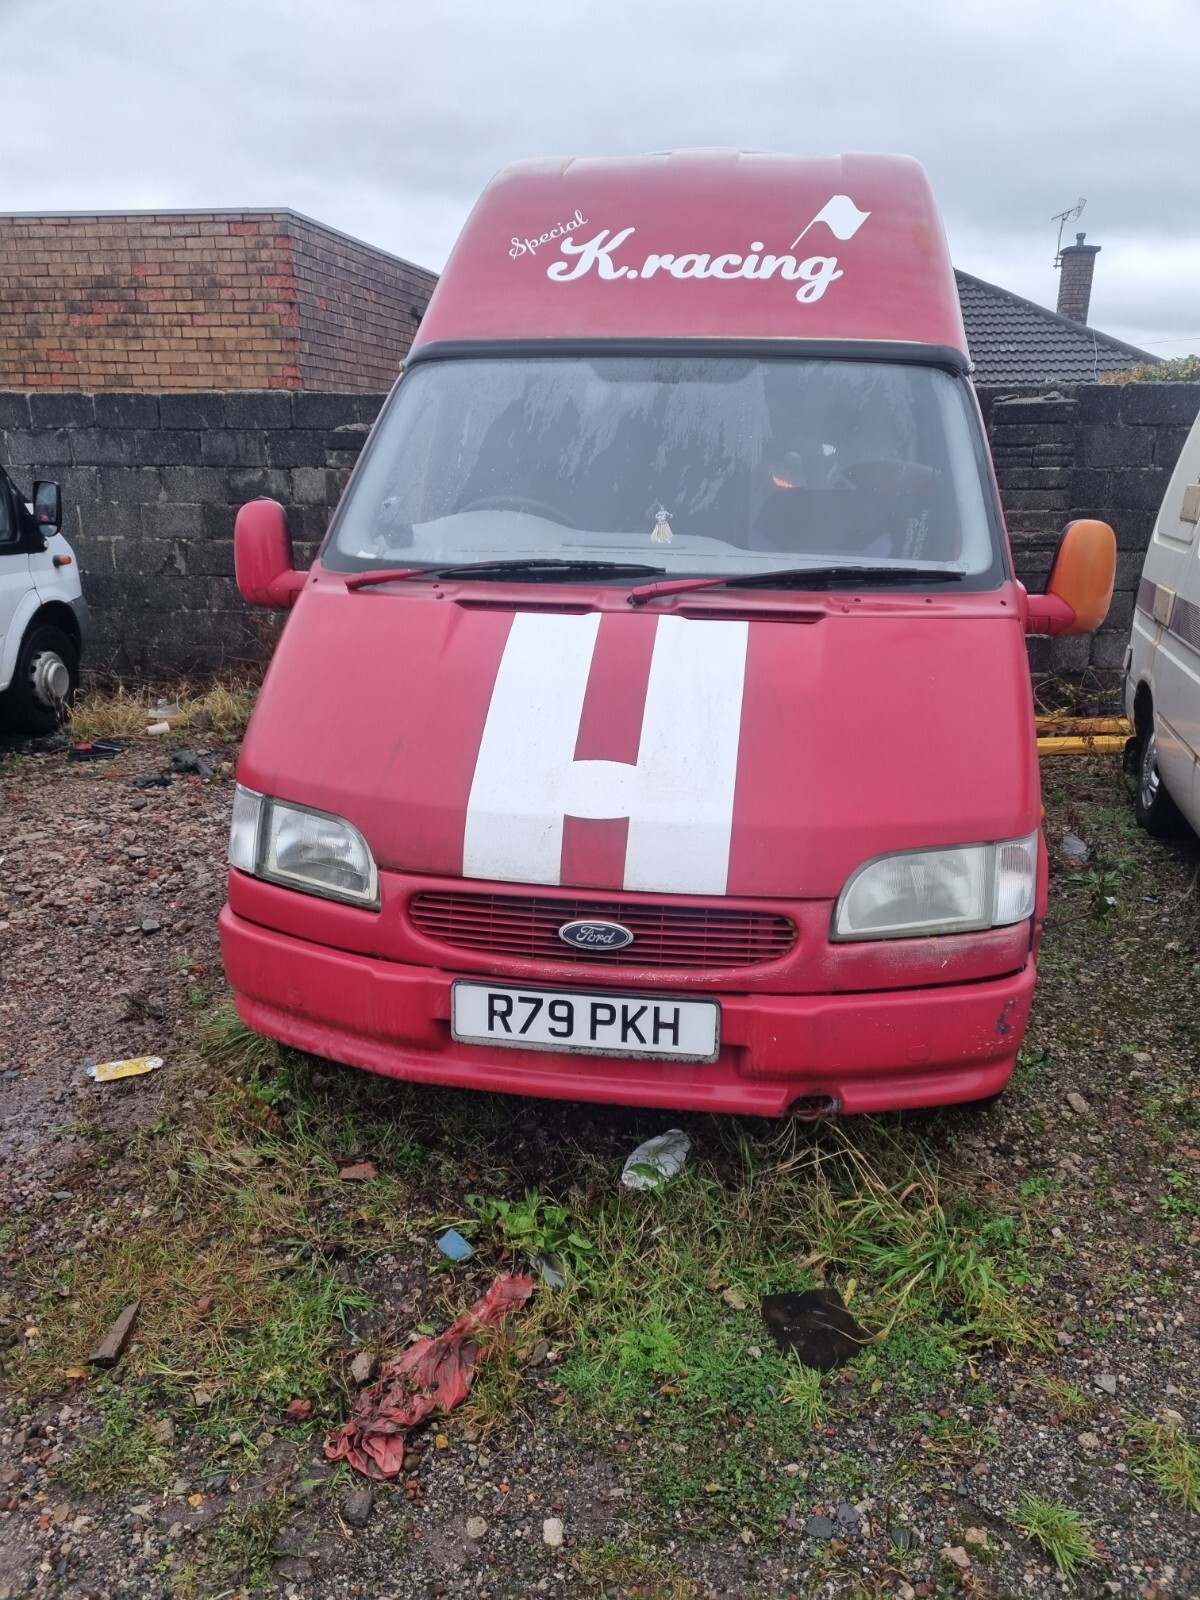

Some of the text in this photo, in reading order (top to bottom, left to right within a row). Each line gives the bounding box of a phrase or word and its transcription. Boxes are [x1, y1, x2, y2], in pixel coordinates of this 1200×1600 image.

[509, 209, 588, 259] Special
[547, 227, 844, 304] K.racing
[575, 925, 616, 945] Ford
[487, 993, 681, 1046] R79 PKH
